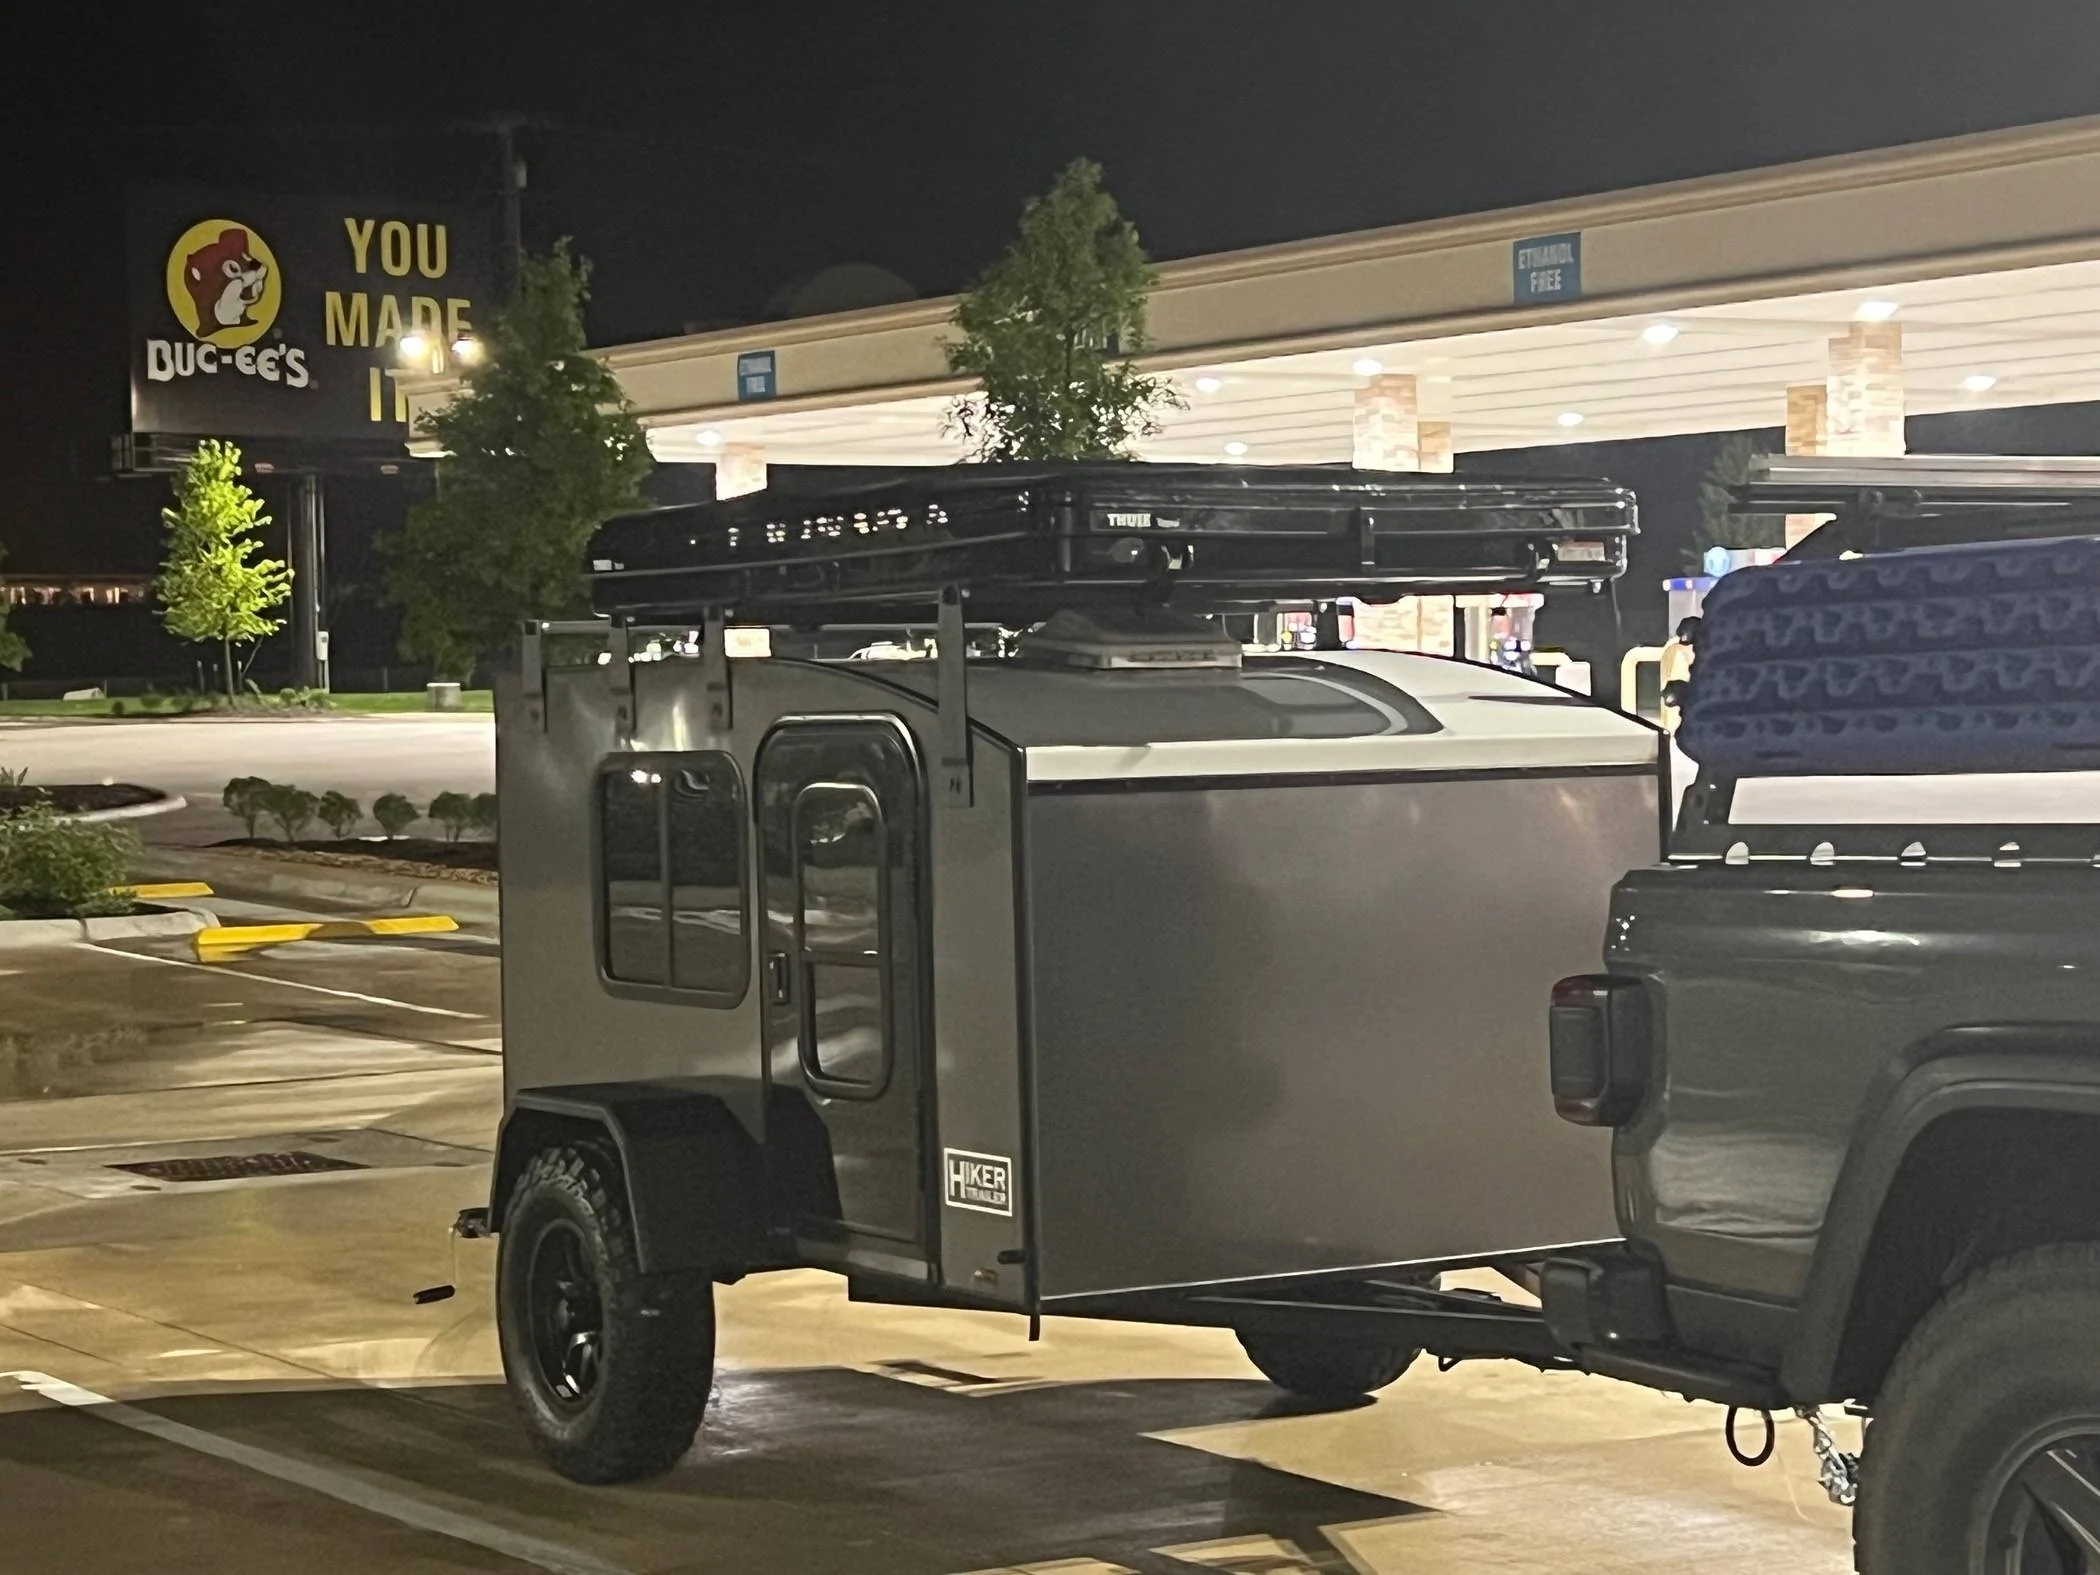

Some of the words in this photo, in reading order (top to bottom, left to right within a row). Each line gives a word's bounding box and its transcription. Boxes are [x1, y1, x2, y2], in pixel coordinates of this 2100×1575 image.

[344, 217, 447, 278] YOU
[325, 291, 473, 348] MADE
[949, 1160, 1006, 1198] HIKER
